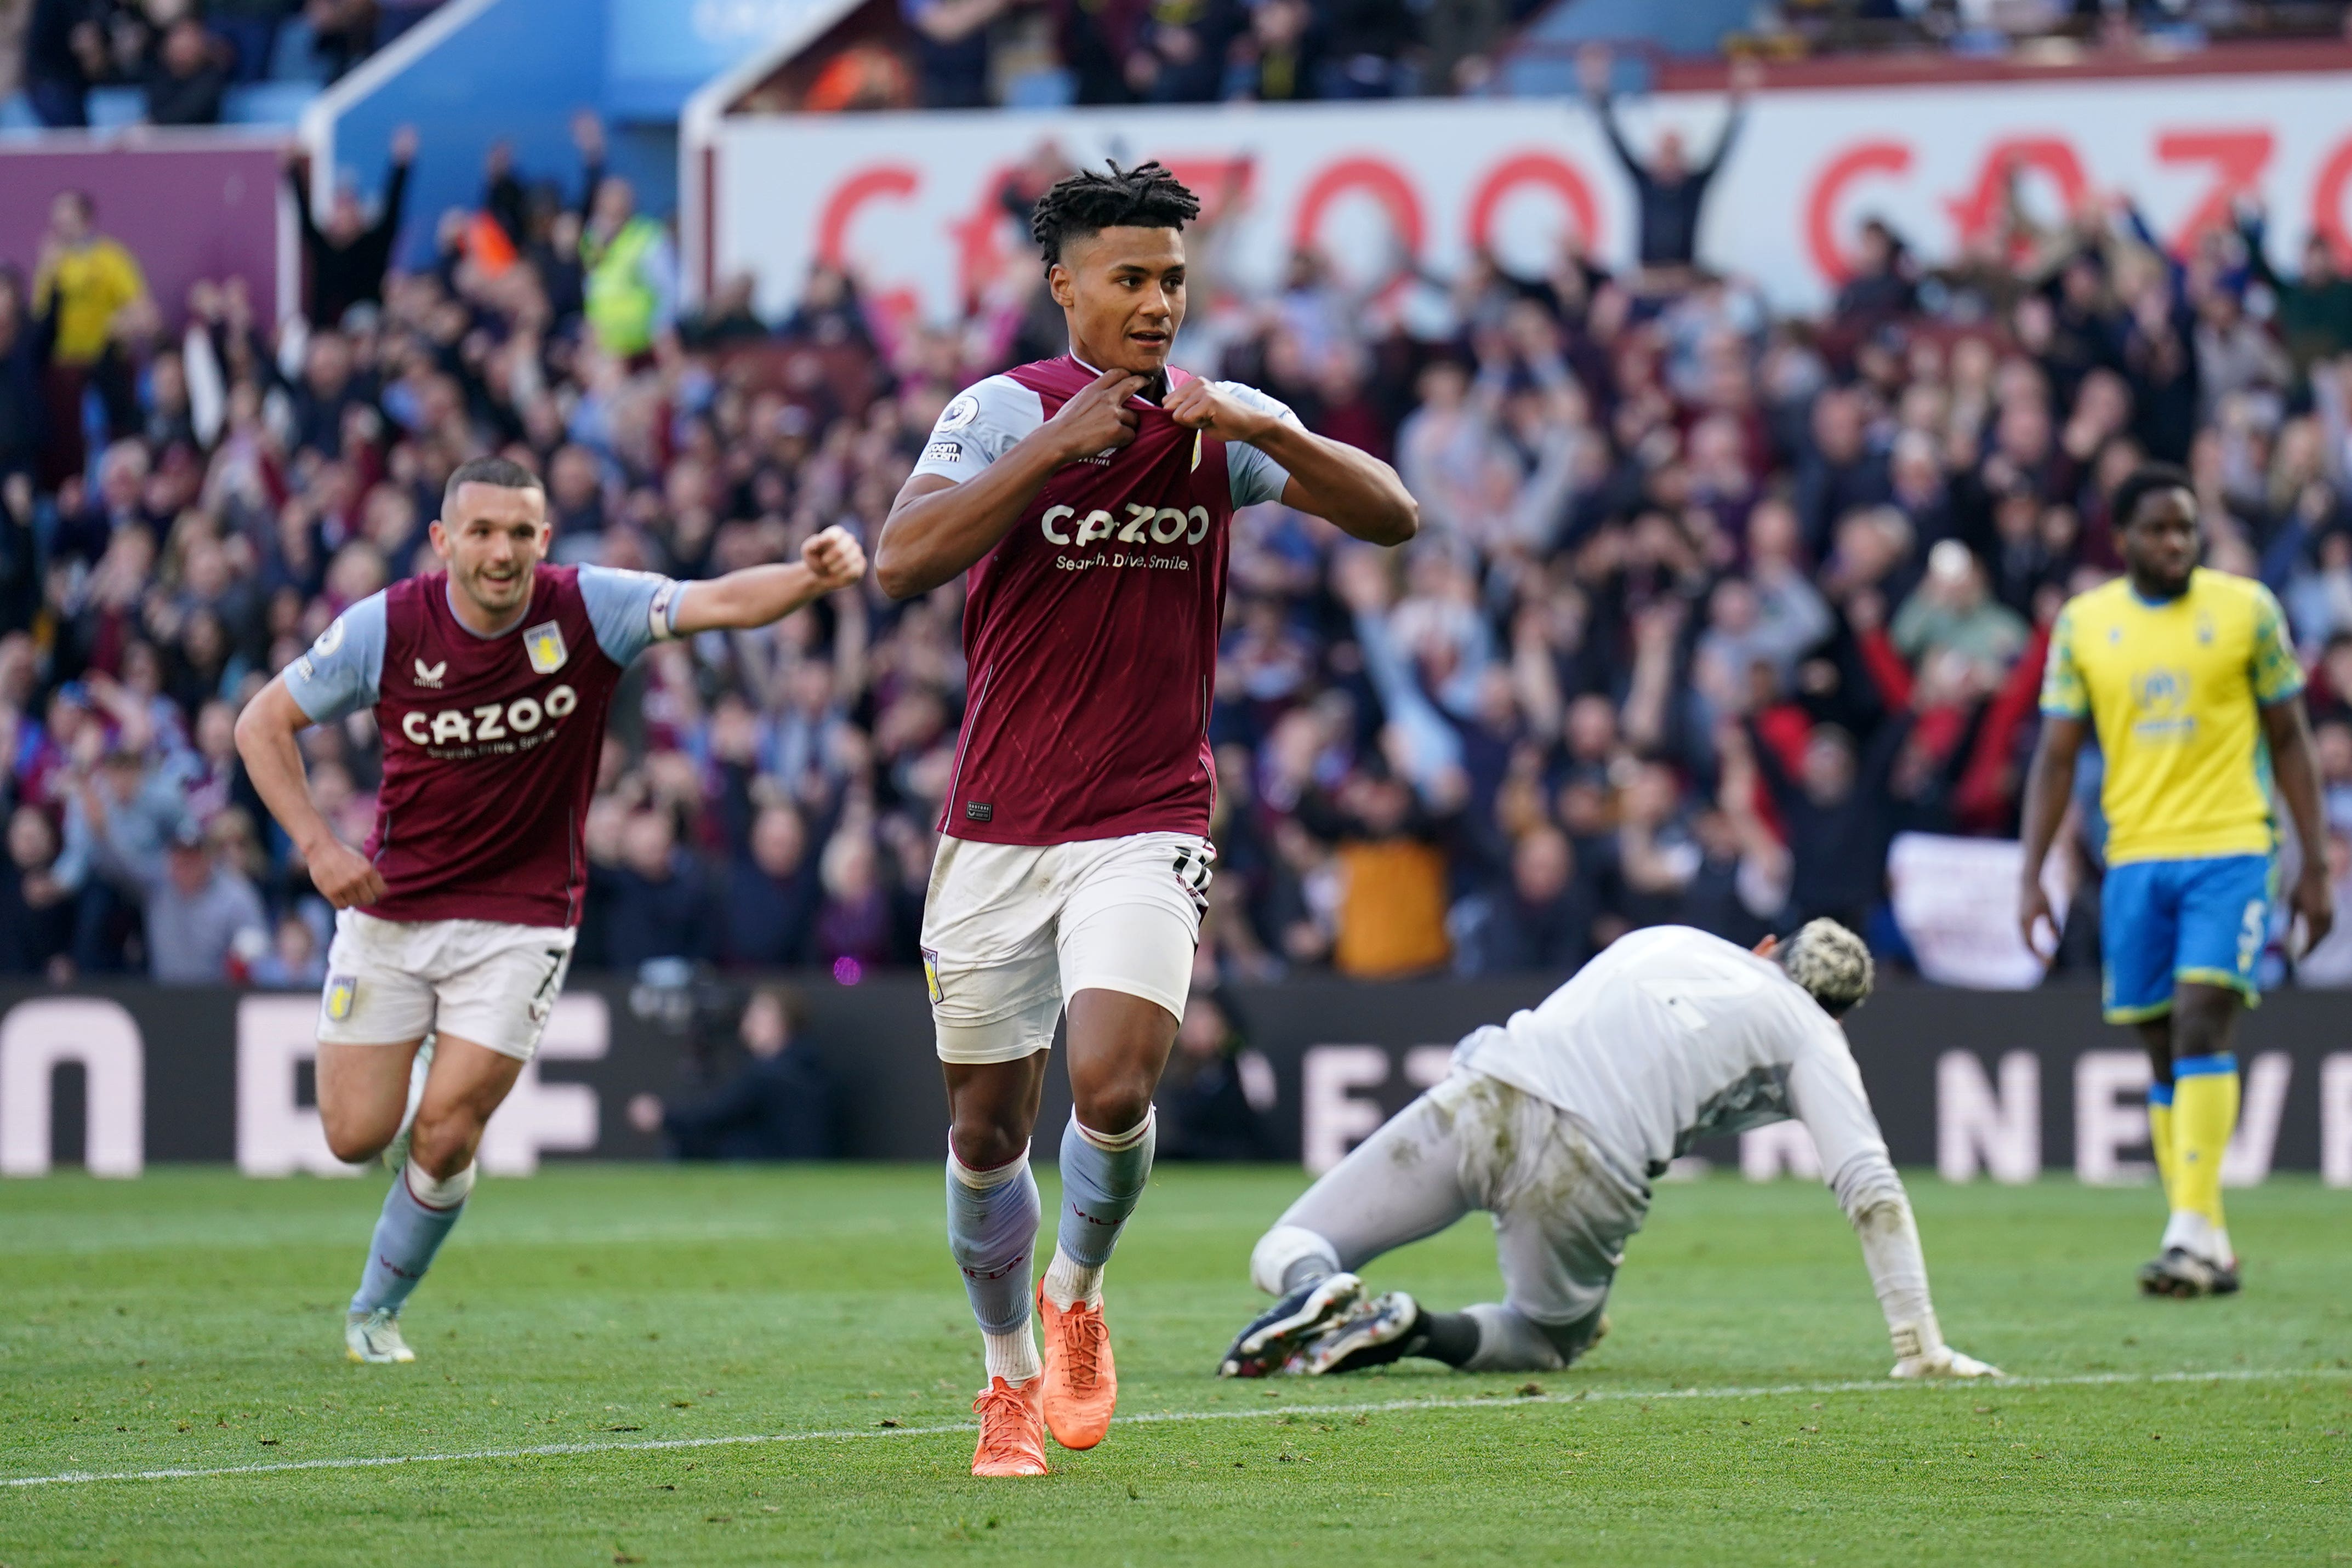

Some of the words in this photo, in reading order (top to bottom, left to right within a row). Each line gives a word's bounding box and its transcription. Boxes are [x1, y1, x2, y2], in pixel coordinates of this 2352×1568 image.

[1041, 503, 1209, 547] CAZOO
[1149, 555, 1189, 571] Smile.
[402, 685, 577, 745] CAZOO
[534, 948, 567, 1000] 7
